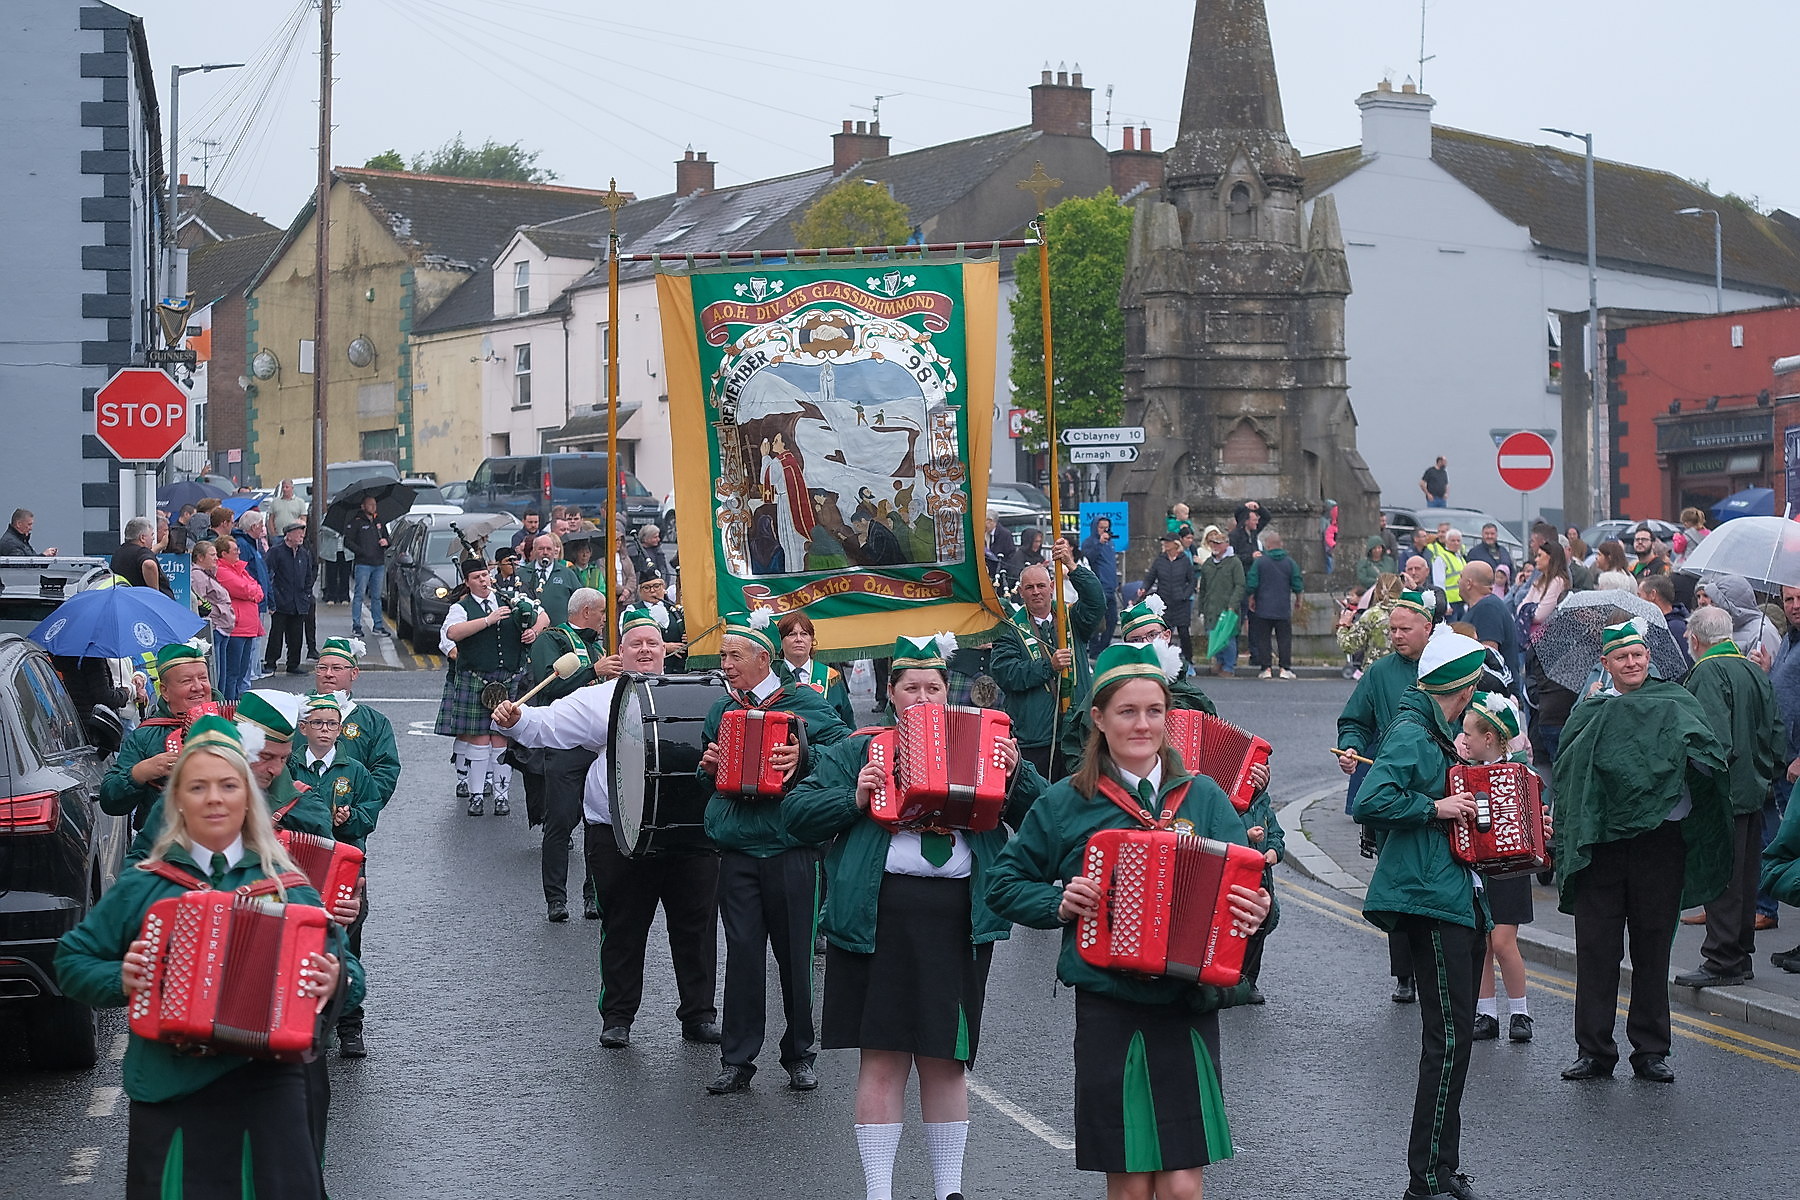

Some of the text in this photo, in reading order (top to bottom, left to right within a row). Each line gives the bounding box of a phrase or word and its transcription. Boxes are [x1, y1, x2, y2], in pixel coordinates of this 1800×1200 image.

[713, 284, 935, 322] A.O.H. DIV. 473 GLASSDRUMMOND
[150, 351, 194, 361] GUINNESS
[722, 350, 770, 426] REMEMBER
[101, 403, 183, 428] STOP
[1073, 431, 1141, 441] C'blayney 10
[1074, 449, 1126, 459] Armagh 8
[1696, 434, 1763, 446] PROPERTY SALES
[734, 716, 742, 772] GUERRINI
[931, 709, 942, 770] GUERRINI
[1191, 715, 1199, 768] GUERRINI
[1153, 844, 1169, 938] GUERRINI
[203, 903, 224, 999] GUERRINI
